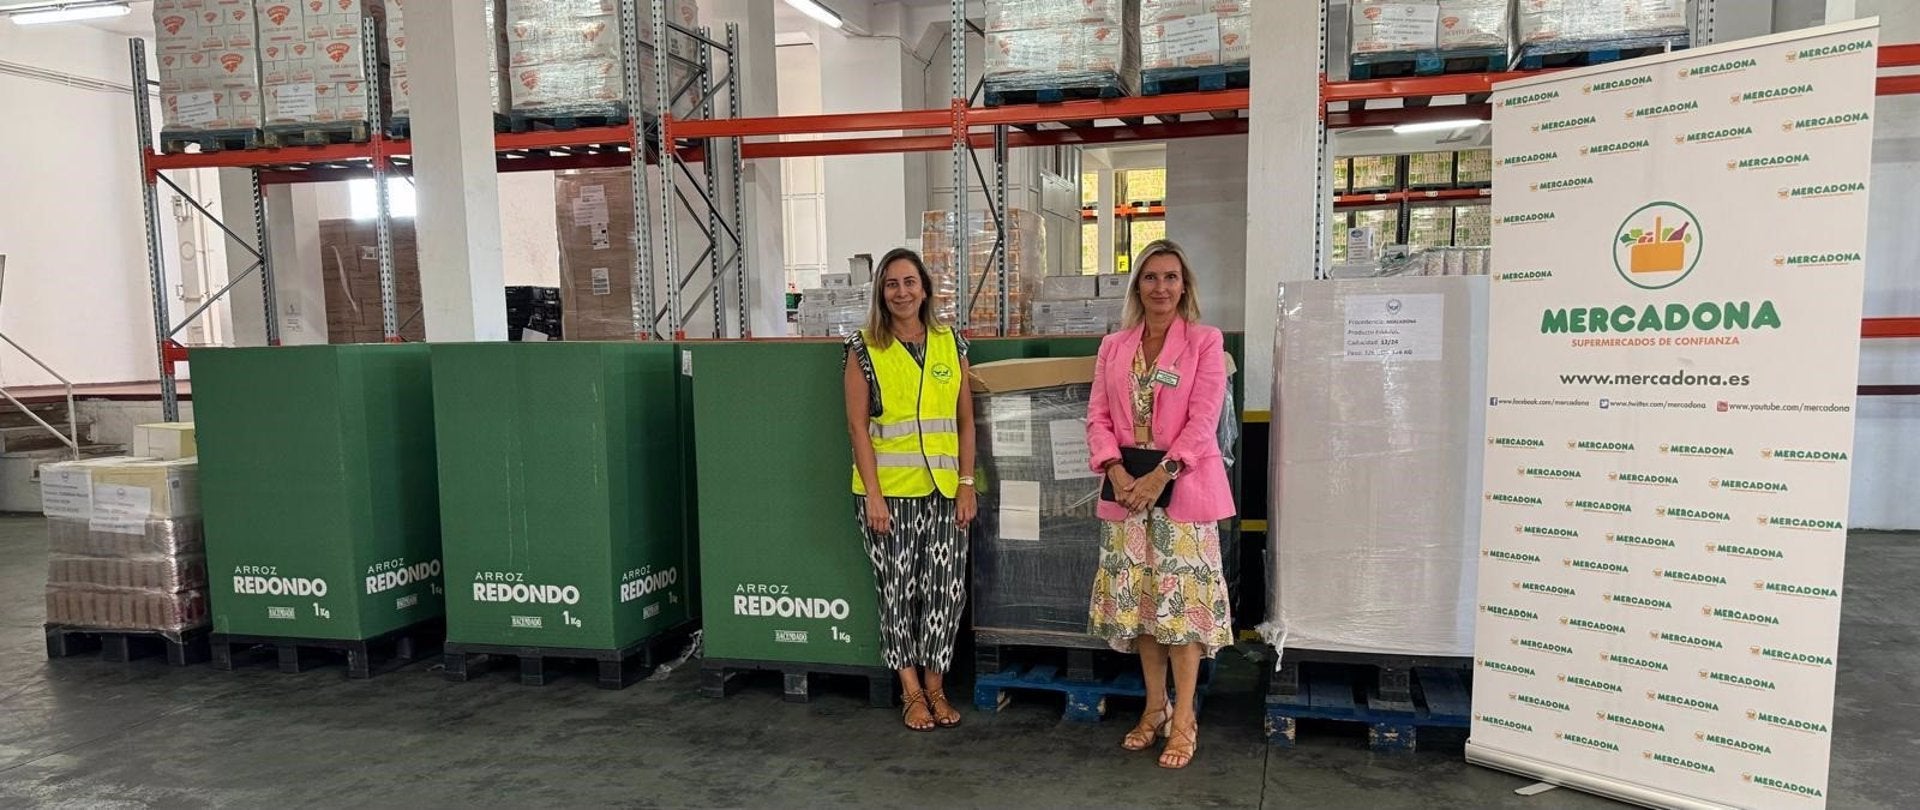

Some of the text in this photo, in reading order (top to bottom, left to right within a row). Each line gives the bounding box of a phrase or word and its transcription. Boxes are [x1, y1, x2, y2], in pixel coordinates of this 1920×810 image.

[1799, 40, 1872, 58] MERCADONA
[1690, 59, 1756, 75] MERCADONA
[1593, 76, 1652, 91] MERCADONA
[1505, 91, 1559, 106] MERCADONA
[1743, 84, 1813, 100] MERCADONA
[1636, 101, 1698, 116] MERCADONA
[1541, 116, 1596, 130] MERCADONA
[1795, 113, 1869, 128] MERCADONA
[1687, 127, 1752, 141] MERCADONA
[1590, 140, 1649, 153] MERCADONA
[1505, 152, 1557, 164] MERCADONA
[1739, 154, 1809, 167] MERCADONA
[1540, 177, 1593, 189] MERCADONA
[1791, 183, 1864, 196] MERCADONA
[1504, 212, 1555, 223] MERCADONA
[1119, 261, 1125, 269] F
[1787, 253, 1861, 264] MERCADONA
[1502, 271, 1552, 280] MERCADONA
[1541, 301, 1781, 334] MERCADONA
[1571, 337, 1740, 347] SUPERMERCADOS DE CONFIANZA
[1560, 370, 1750, 386] www.mercadona.es
[1729, 402, 1850, 413] www.youtube.com/mercadona
[1496, 438, 1544, 446] MERCADONA
[1578, 441, 1634, 450] MERCADONA
[1670, 445, 1734, 454] MERCADONA
[1774, 450, 1847, 460] MERCADONA
[1526, 468, 1581, 477] MERCADONA
[1619, 474, 1678, 483] MERCADONA
[1721, 480, 1788, 491] MERCADONA
[1493, 494, 1542, 504] MERCADONA
[1575, 500, 1632, 512] MERCADONA
[1667, 508, 1730, 520] MERCADONA
[1770, 517, 1842, 529] MERCADONA
[1524, 526, 1578, 537] MERCADONA
[1616, 535, 1675, 547] MERCADONA
[1490, 551, 1540, 562] MERCADONA
[1717, 545, 1783, 558] MERCADONA
[235, 565, 277, 576] ARROZ
[367, 558, 404, 574] ARROZ
[622, 564, 652, 582] ARROZ
[1572, 560, 1628, 572] MERCADONA
[366, 559, 441, 595] REDONDO
[475, 571, 524, 582] ARROZ
[1664, 570, 1726, 584] MERCADONA
[233, 576, 327, 597] REDONDO
[620, 566, 677, 603] REDONDO
[736, 583, 790, 594] ARROZ
[1522, 583, 1575, 595] MERCADONA
[1766, 583, 1837, 596] MERCADONA
[473, 582, 580, 605] REDONDO
[733, 595, 850, 620] REDONDO
[1613, 595, 1672, 608] MERCADONA
[1487, 606, 1538, 619] MERCADONA
[1714, 608, 1779, 624] MERCADONA
[1570, 619, 1625, 633] MERCADONA
[1520, 639, 1573, 653] MERCADONA
[1661, 633, 1722, 648] MERCADONA
[1610, 655, 1668, 670] MERCADONA
[1762, 648, 1832, 665] MERCADONA
[1485, 661, 1535, 675] MERCADONA
[1567, 676, 1622, 692] MERCADONA
[1710, 672, 1775, 689] MERCADONA
[1518, 695, 1570, 710] MERCADONA
[1657, 693, 1719, 710] MERCADONA
[1483, 716, 1532, 731] MERCADONA
[1607, 713, 1665, 731] MERCADONA
[1758, 713, 1827, 732] MERCADONA
[1564, 734, 1619, 751] MERCADONA
[1706, 734, 1771, 753] MERCADONA
[1654, 753, 1715, 772] MERCADONA
[1754, 776, 1822, 797] MERCADONA
